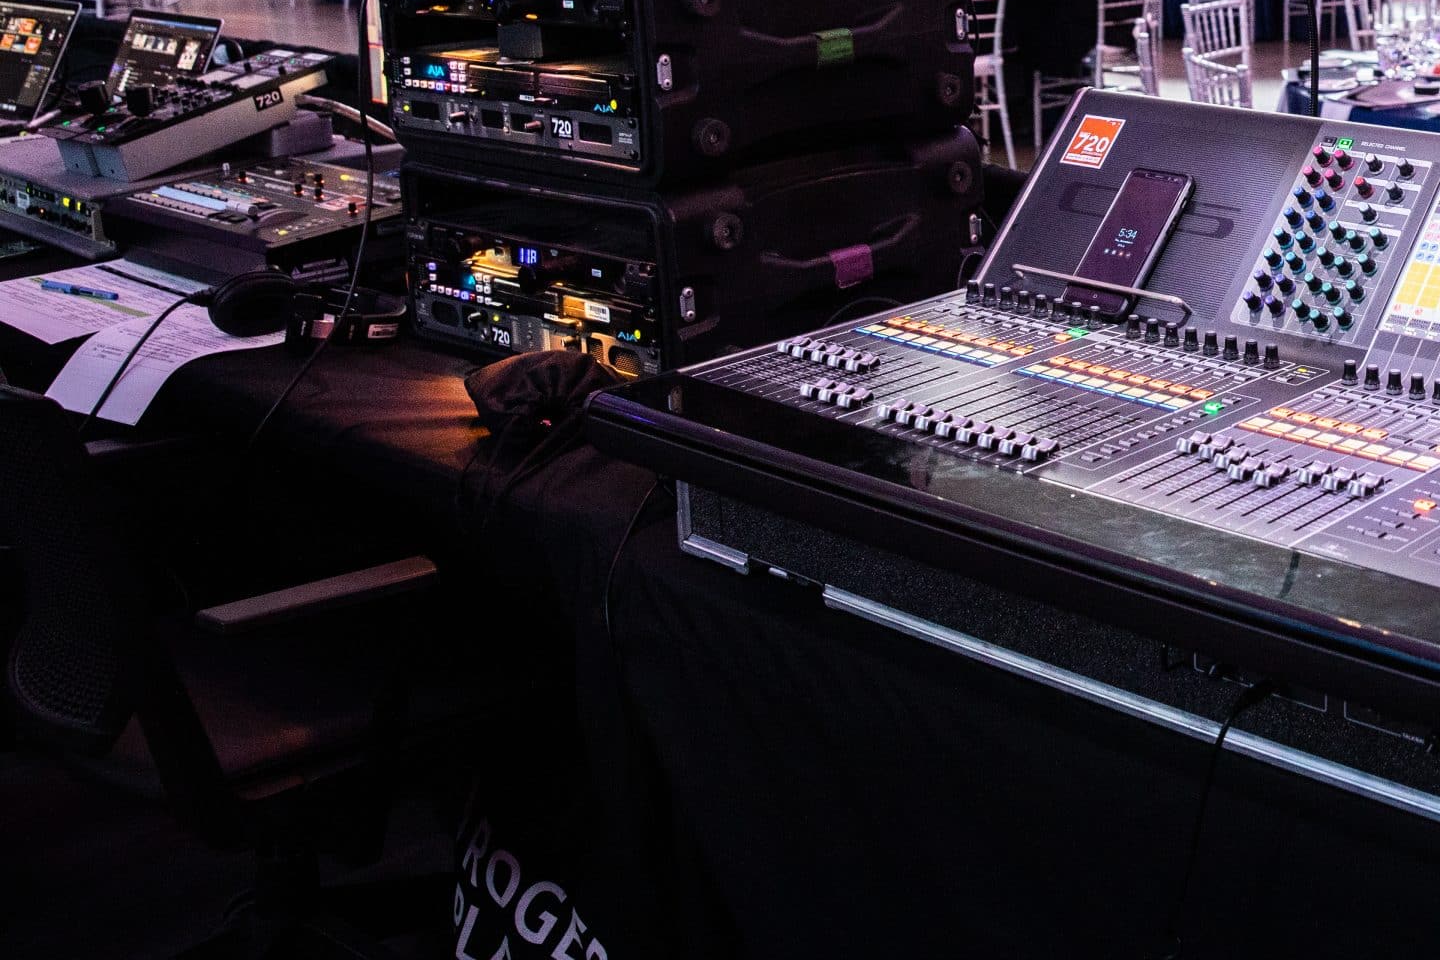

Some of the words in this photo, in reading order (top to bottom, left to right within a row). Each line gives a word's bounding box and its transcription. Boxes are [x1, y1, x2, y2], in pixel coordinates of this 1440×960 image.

[255, 91, 280, 108] 720
[552, 117, 572, 135] 720
[1073, 132, 1110, 153] 720
[1118, 228, 1138, 239] 5:34
[492, 327, 510, 344] 720
